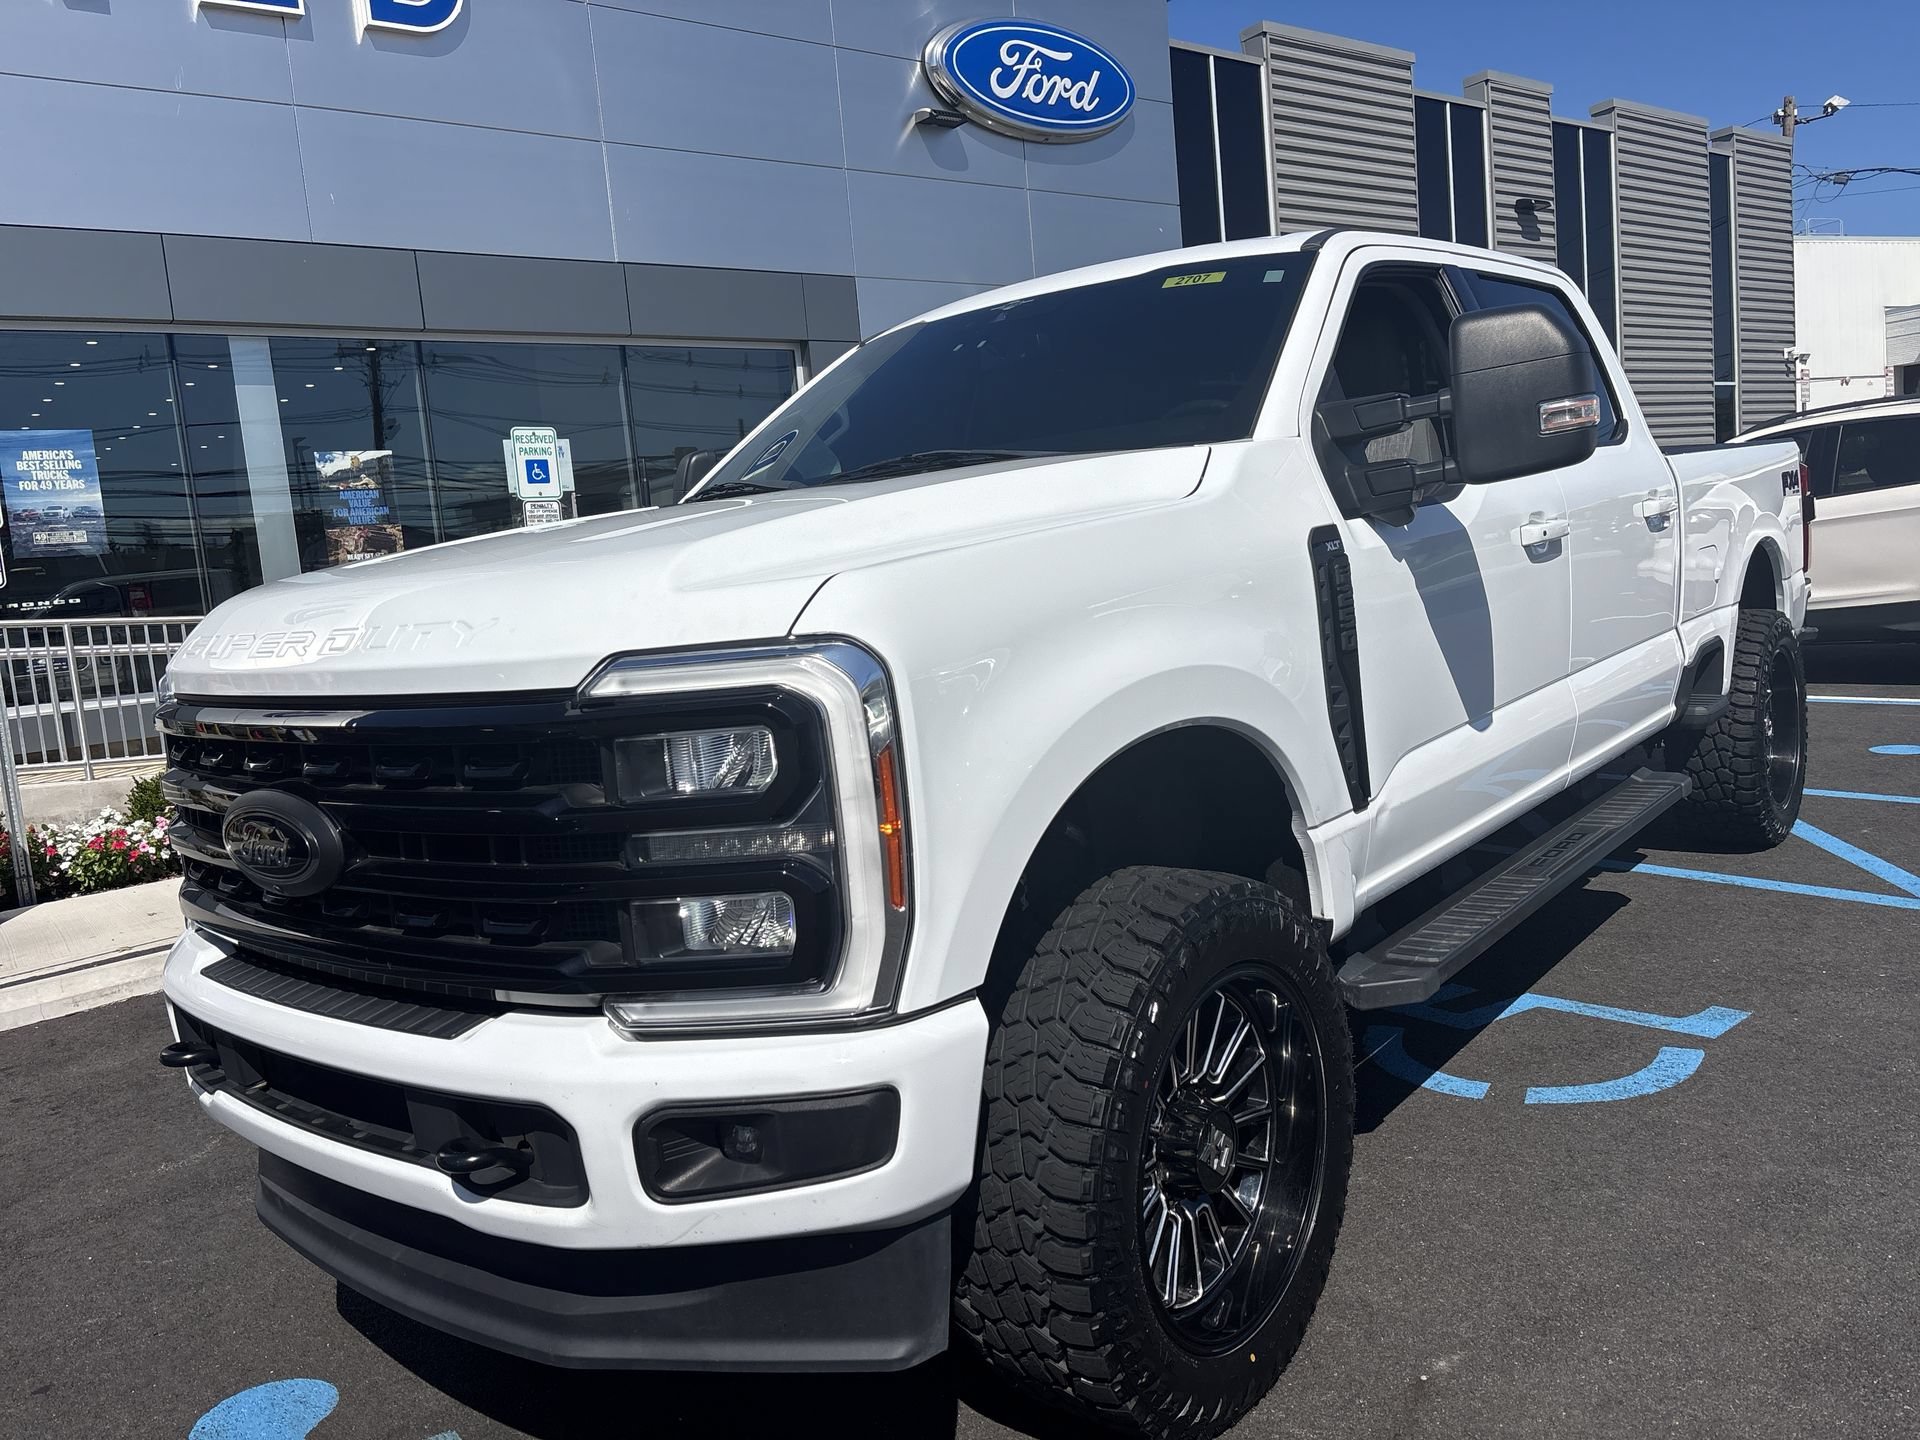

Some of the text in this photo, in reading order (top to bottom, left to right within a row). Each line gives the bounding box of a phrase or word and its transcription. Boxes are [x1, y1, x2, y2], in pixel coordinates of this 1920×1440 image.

[989, 39, 1101, 112] Ford
[1174, 274, 1212, 286] 2707
[515, 434, 554, 444] RESERVED
[22, 450, 74, 460] AMERICA'S
[519, 447, 553, 456] PARKING
[16, 460, 82, 471] BEST-SELLING
[31, 470, 70, 481] TRUCKS
[18, 479, 86, 491] FOR 49 YEARS
[339, 490, 379, 500] AMERICAN
[348, 499, 375, 508] VALUE.
[333, 506, 390, 518] FOR AMERICAN
[349, 516, 379, 525] VALUES.
[1325, 540, 1341, 552] XLT
[0, 598, 81, 609] RONCO
[183, 617, 500, 661] SUPER DUTY
[239, 821, 293, 869] Ford
